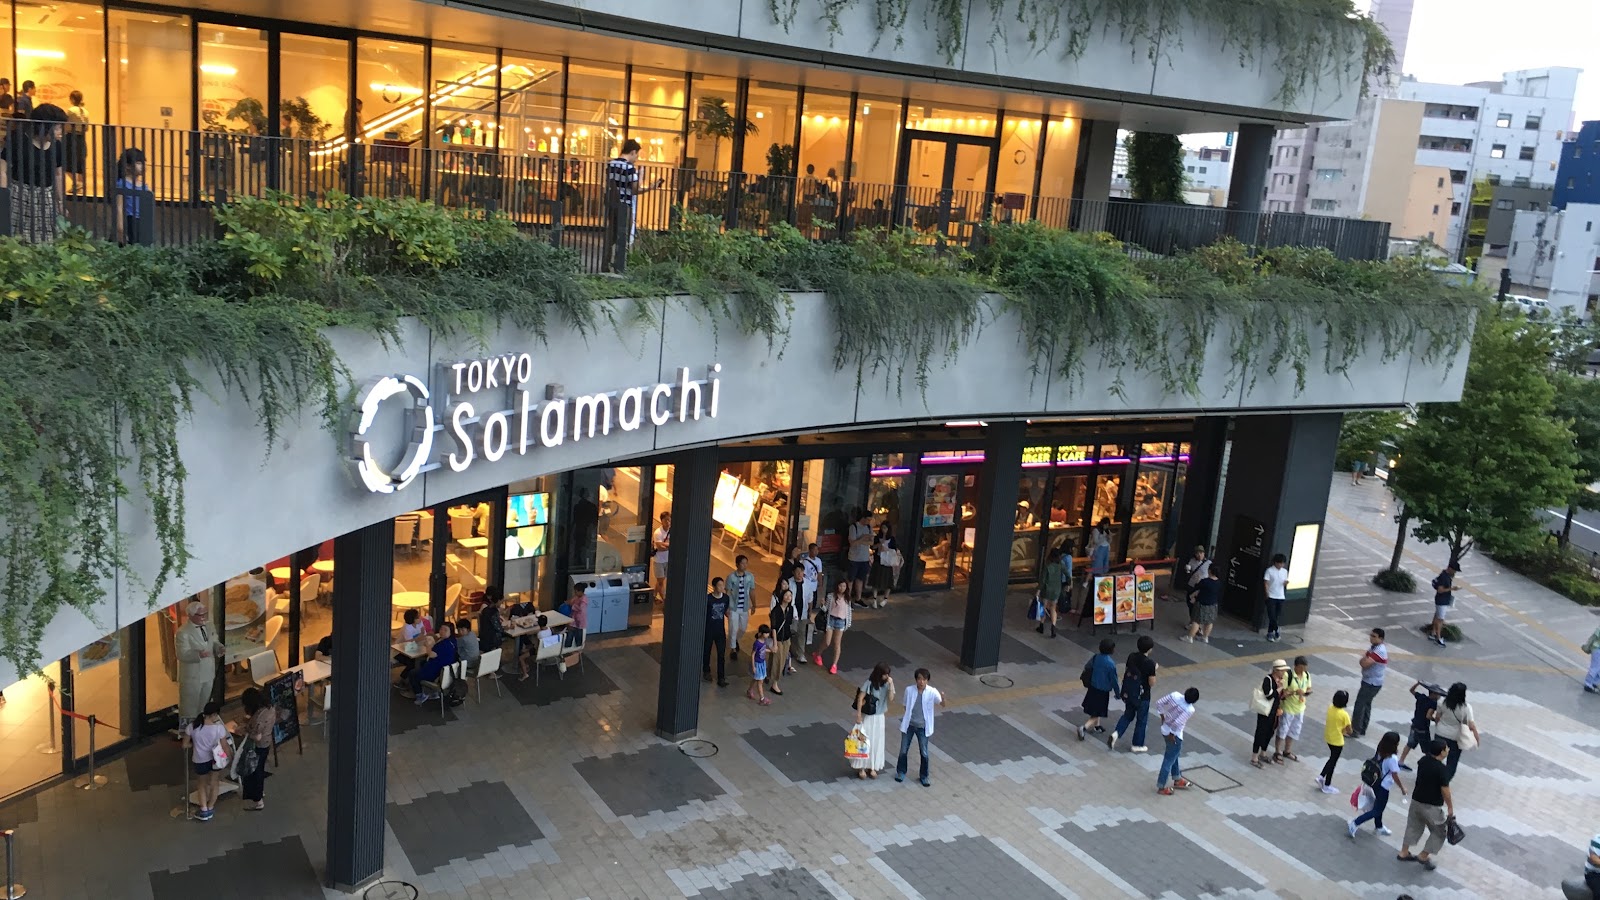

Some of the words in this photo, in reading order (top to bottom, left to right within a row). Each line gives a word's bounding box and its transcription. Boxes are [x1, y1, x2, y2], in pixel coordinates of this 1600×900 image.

[452, 353, 532, 395] TOKYO
[449, 363, 722, 473] Solamachi
[1062, 451, 1086, 462] CAFE
